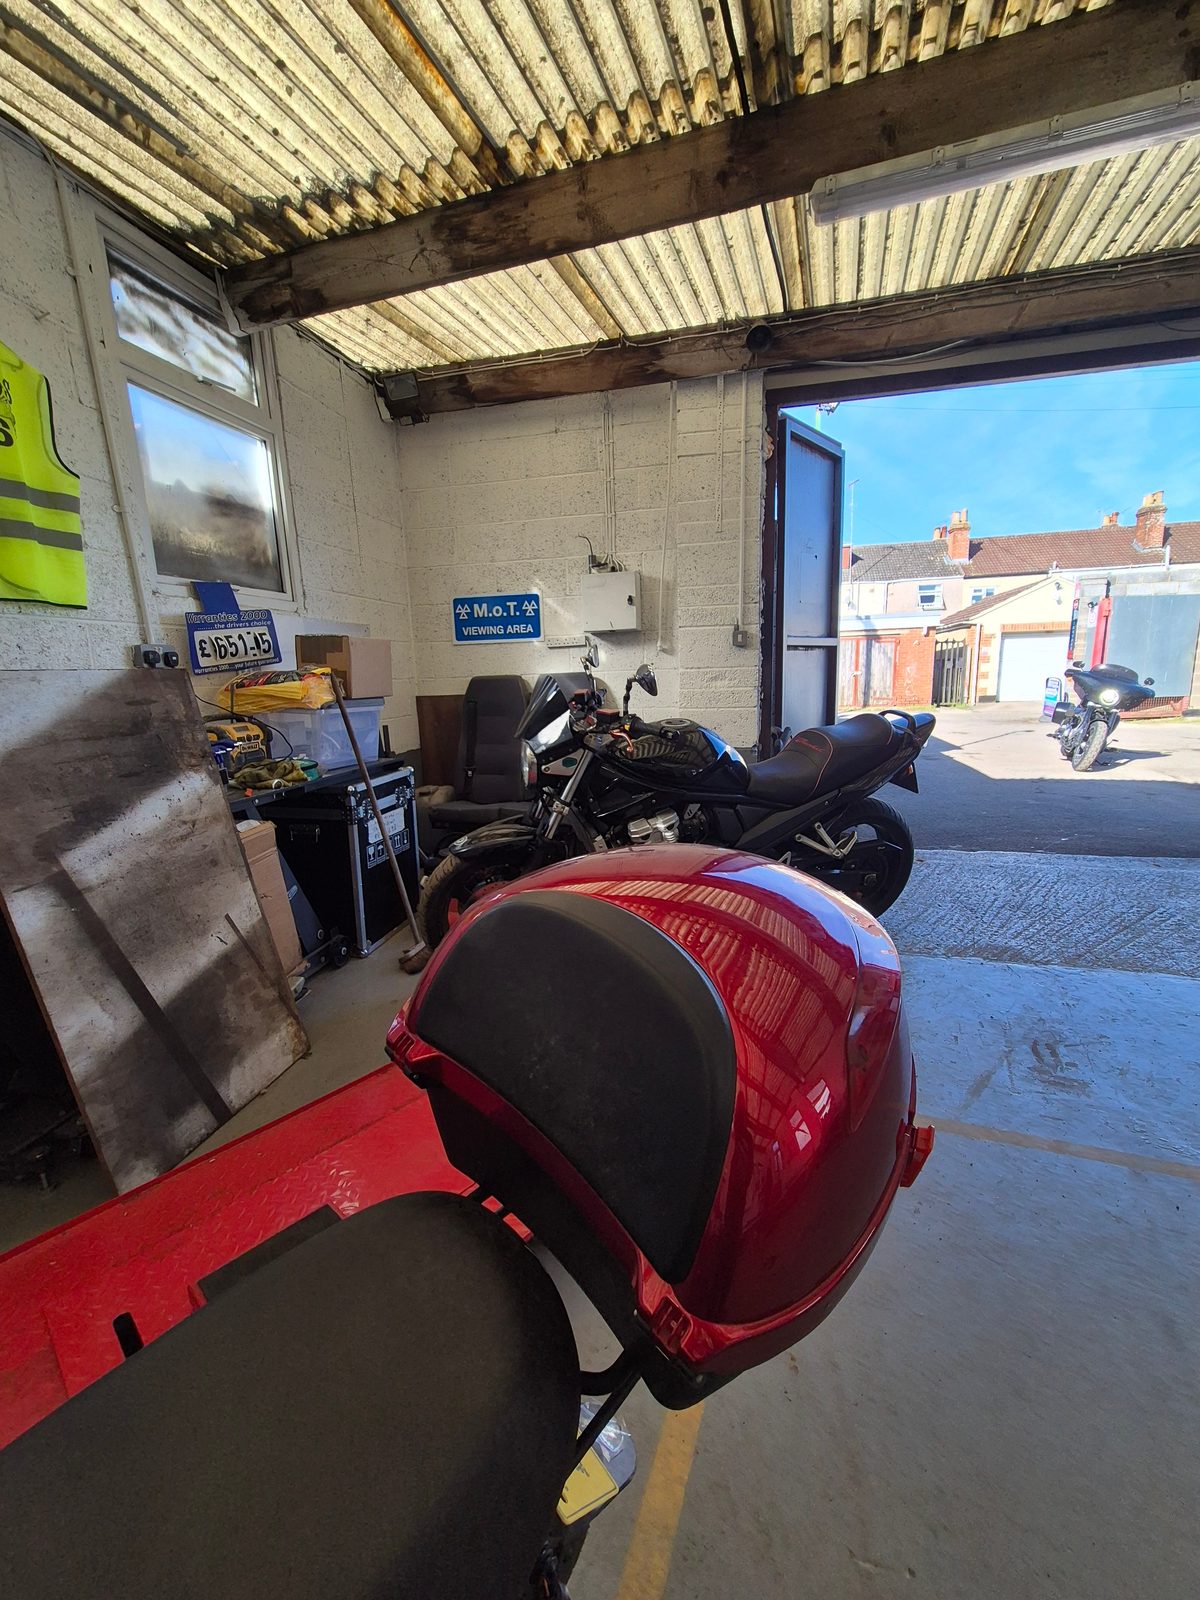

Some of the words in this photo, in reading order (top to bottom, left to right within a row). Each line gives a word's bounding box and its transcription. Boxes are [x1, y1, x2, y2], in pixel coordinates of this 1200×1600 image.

[473, 601, 520, 618] M.o.T.
[186, 611, 238, 624] Warranties
[240, 610, 268, 621] 2000
[226, 621, 249, 629] drivers
[462, 625, 504, 636] VIEWING
[506, 624, 534, 634] AREA
